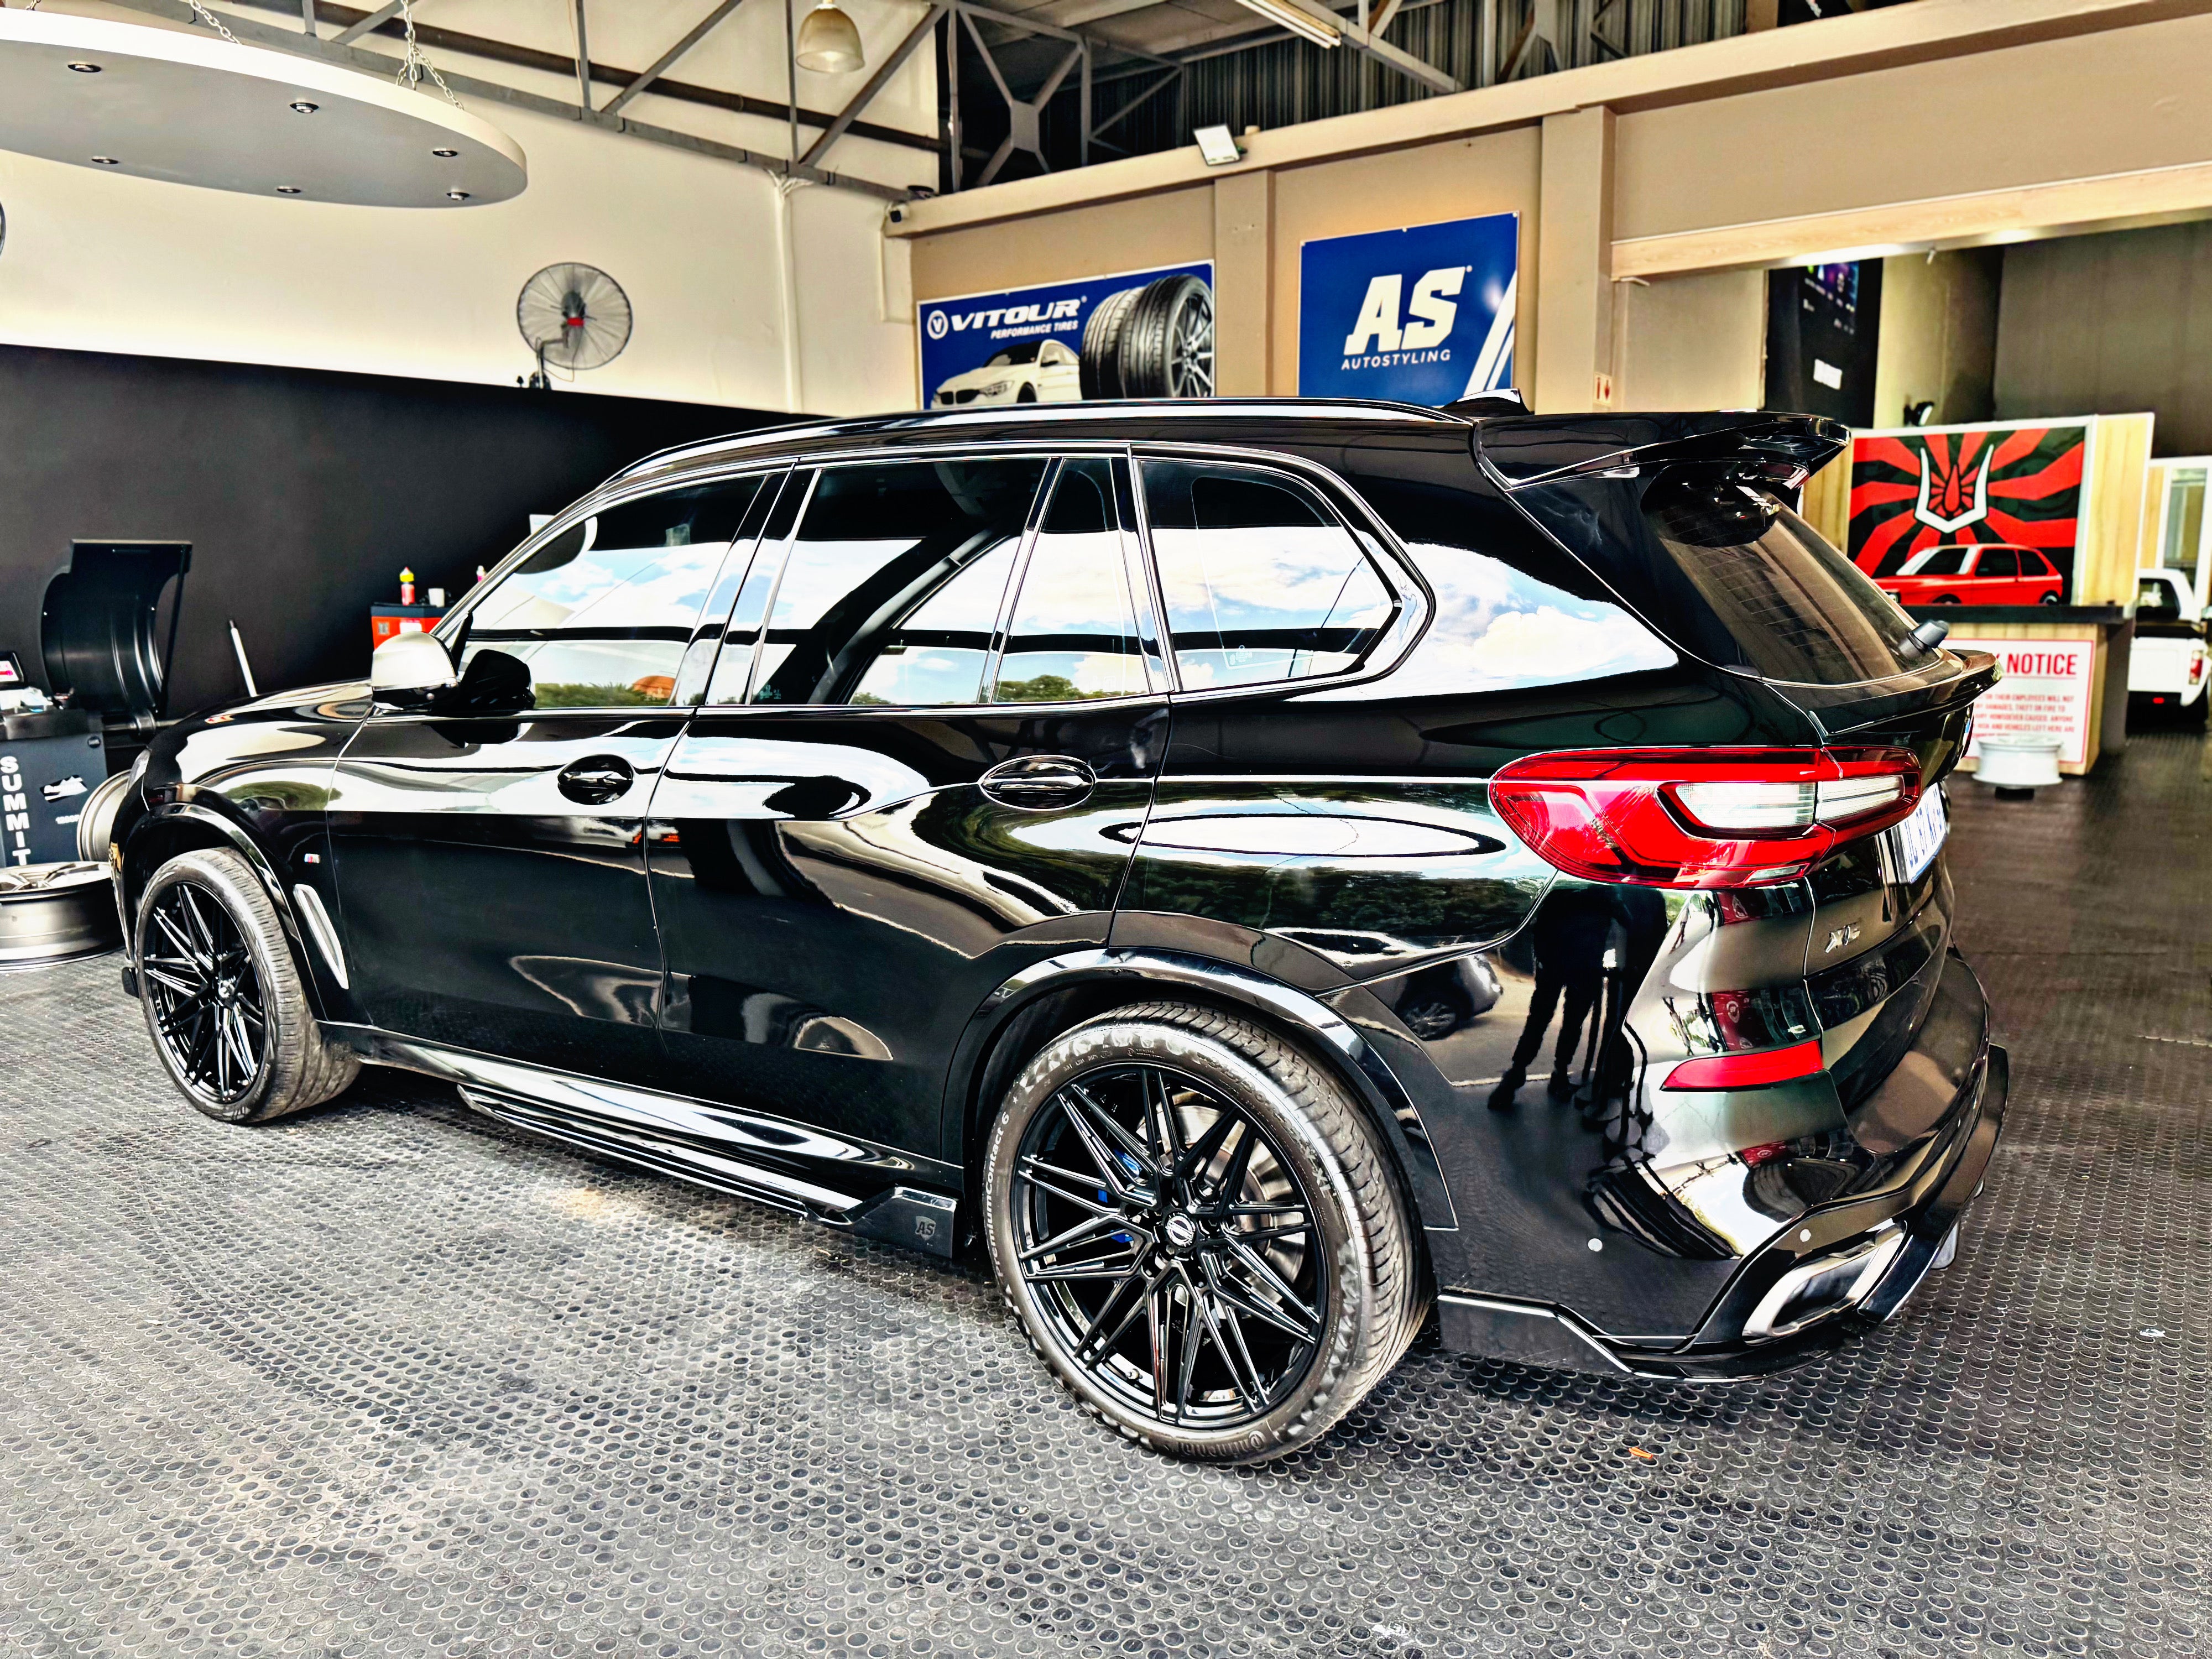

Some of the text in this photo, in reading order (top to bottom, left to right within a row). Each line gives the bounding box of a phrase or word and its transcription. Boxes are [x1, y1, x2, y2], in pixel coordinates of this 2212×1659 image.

[951, 299, 1081, 331] VITOUR
[1343, 266, 1466, 355] AS
[990, 320, 1078, 339] PERFORMANCE TIRES
[1341, 348, 1451, 371] AUTOSTYLING
[2006, 653, 2078, 675] NOTICE
[0, 756, 31, 866] SUMMIT
[985, 1111, 1010, 1278] PremiumContact 6
[916, 1220, 935, 1236] AS
